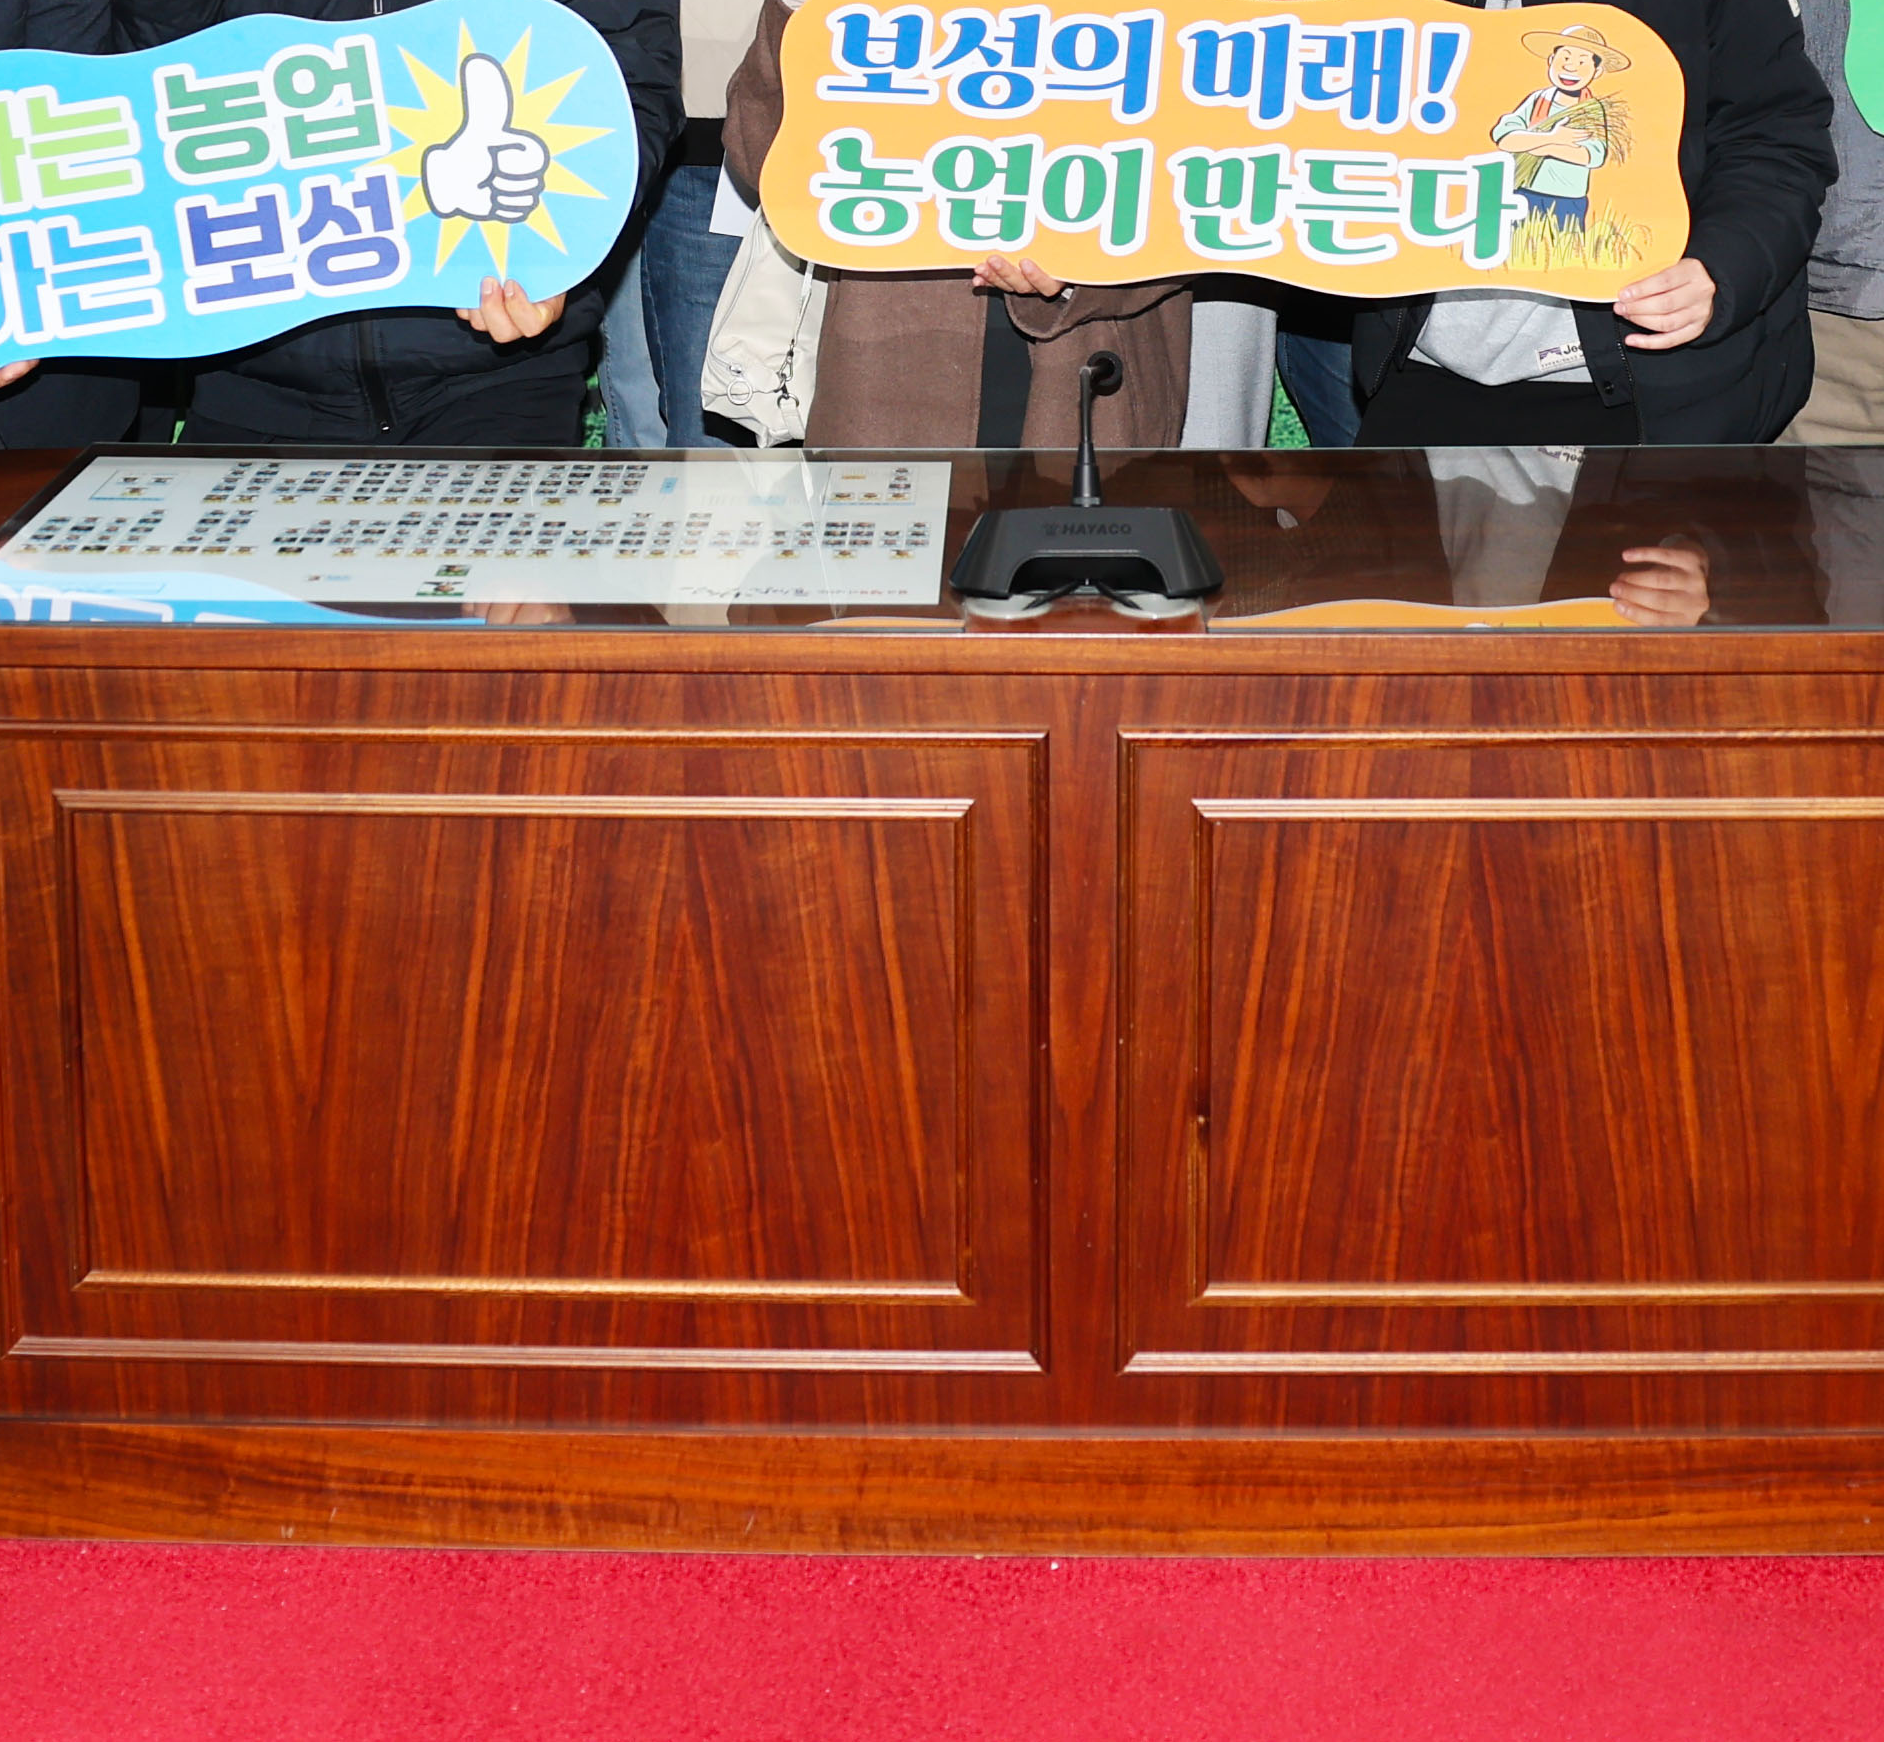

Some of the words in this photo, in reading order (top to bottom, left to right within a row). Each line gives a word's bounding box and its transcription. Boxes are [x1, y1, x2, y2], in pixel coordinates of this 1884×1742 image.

[162, 43, 382, 177] 농업
[824, 9, 1155, 116] 보성의
[1187, 22, 1464, 127] 미래!
[185, 174, 403, 307] 보성
[818, 137, 1148, 251] 농업이
[1177, 150, 1519, 262] 만든다
